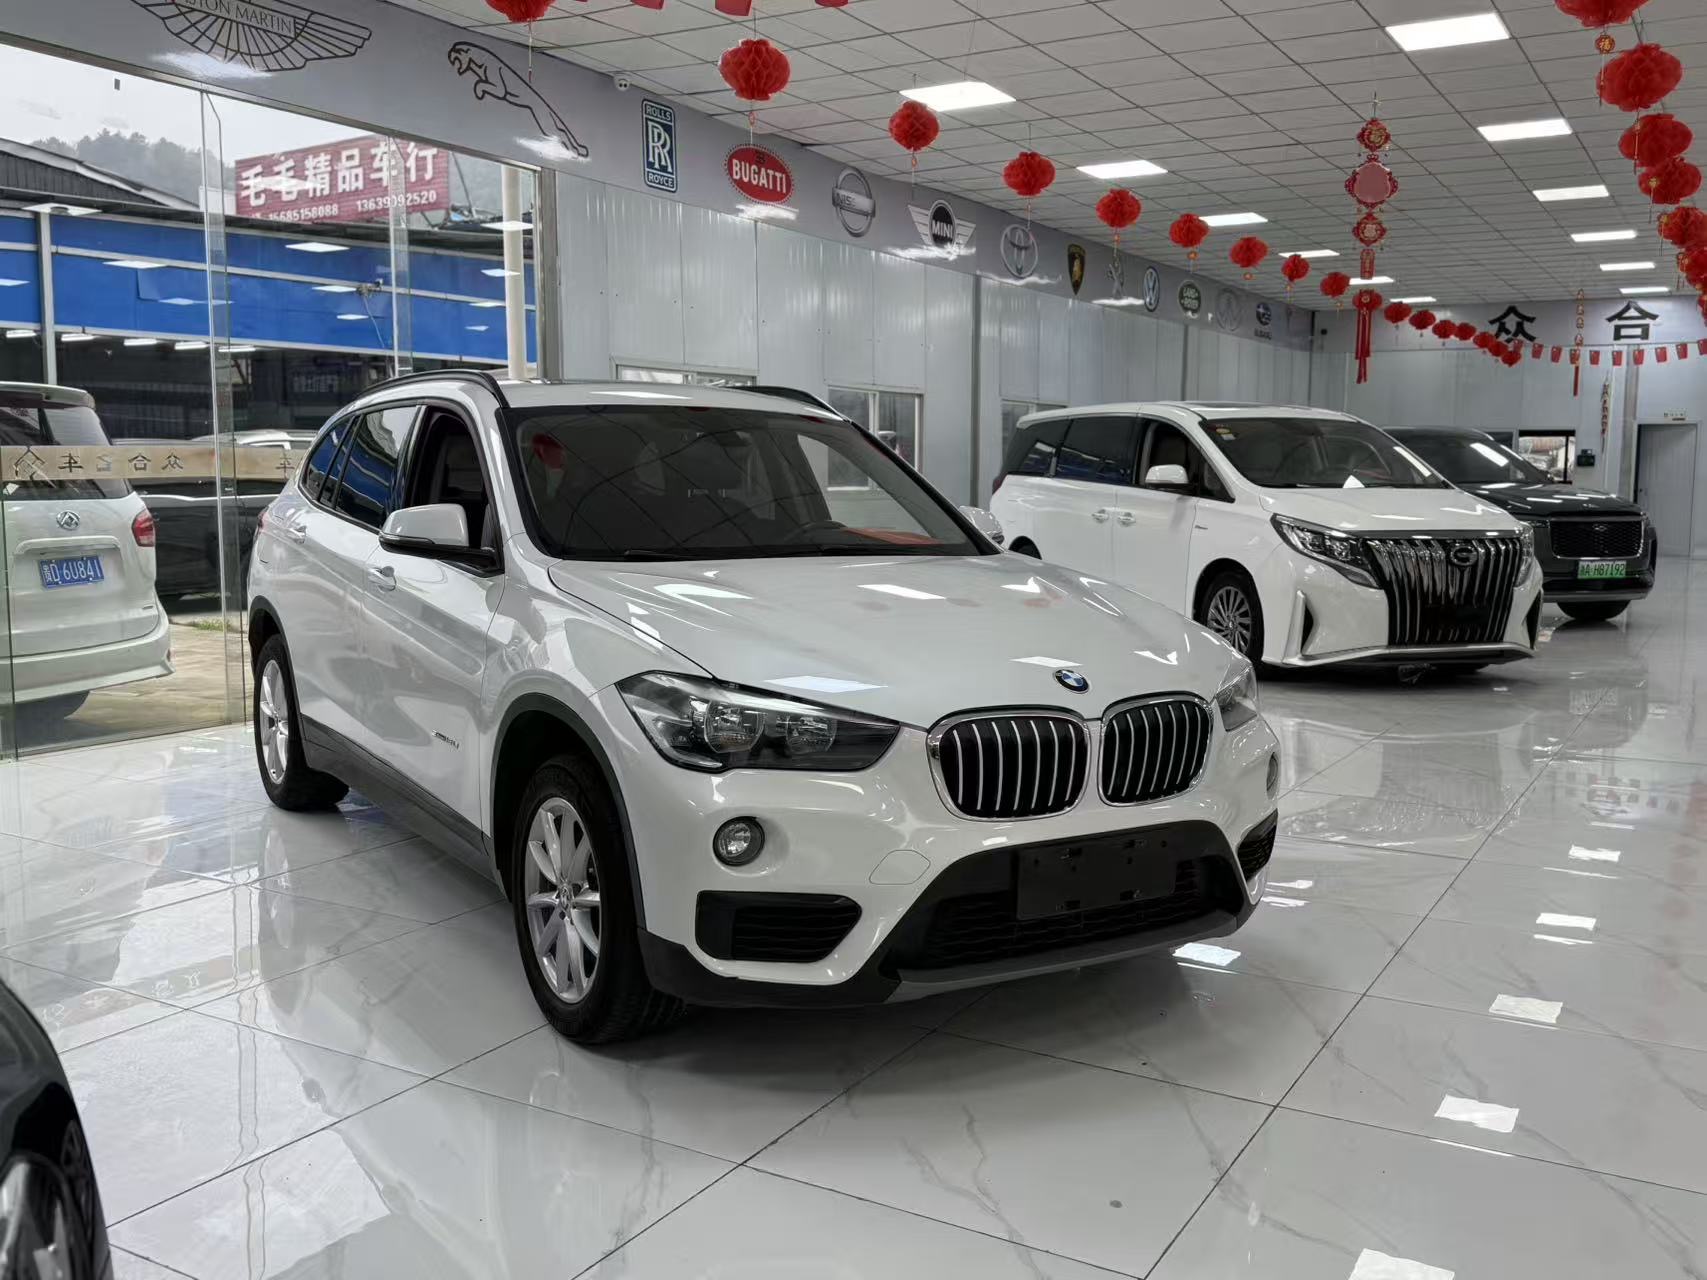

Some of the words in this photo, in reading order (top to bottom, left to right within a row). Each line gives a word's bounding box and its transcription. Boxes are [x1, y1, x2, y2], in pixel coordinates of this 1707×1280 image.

[235, 7, 292, 33] MARTIN
[646, 103, 672, 121] ROLLS
[239, 142, 438, 207] 毛毛精品车行
[648, 172, 674, 187] ROYCE
[732, 158, 787, 194] BUGATTI
[356, 190, 437, 212] 13639092520
[932, 219, 953, 238] MINI
